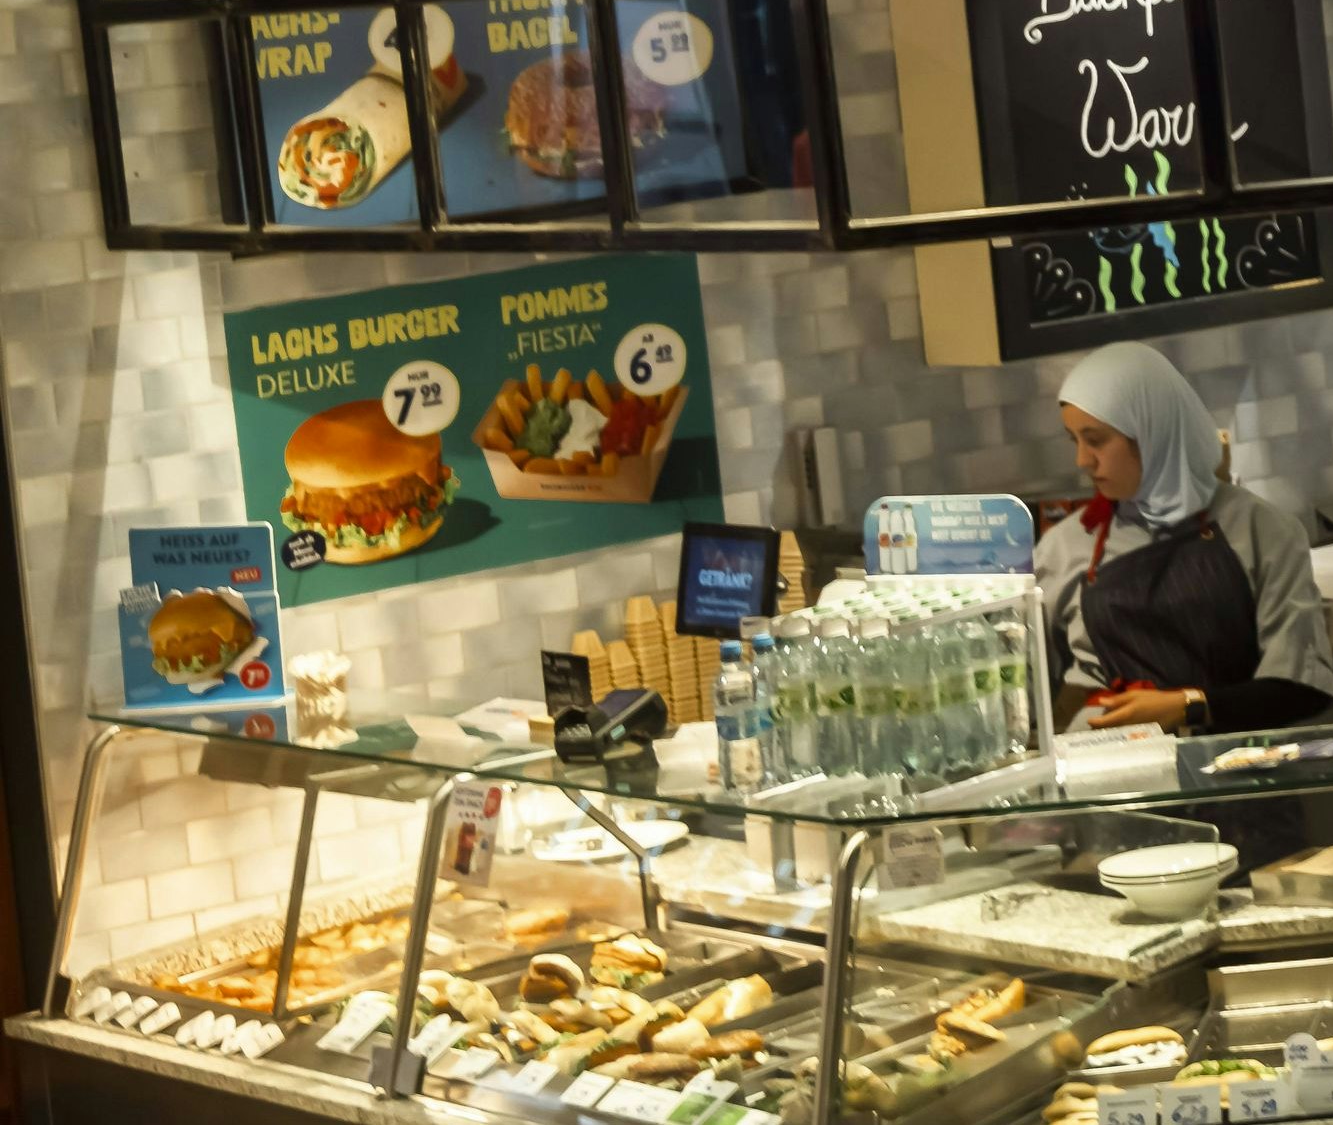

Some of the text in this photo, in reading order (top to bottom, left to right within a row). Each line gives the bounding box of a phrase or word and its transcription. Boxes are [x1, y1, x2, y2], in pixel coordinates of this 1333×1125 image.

[251, 10, 341, 40] ACHS-
[487, 16, 578, 54] BAGEL
[651, 38, 667, 63] 5
[501, 282, 609, 325] POMMES
[251, 305, 460, 365] LACHS BURGER
[257, 361, 356, 399] DELUXE
[630, 348, 653, 385] 6
[394, 387, 416, 426] 7
[152, 549, 252, 566] WAS NEUES?
[209, 532, 241, 546] AUF
[233, 568, 259, 582] NEU
